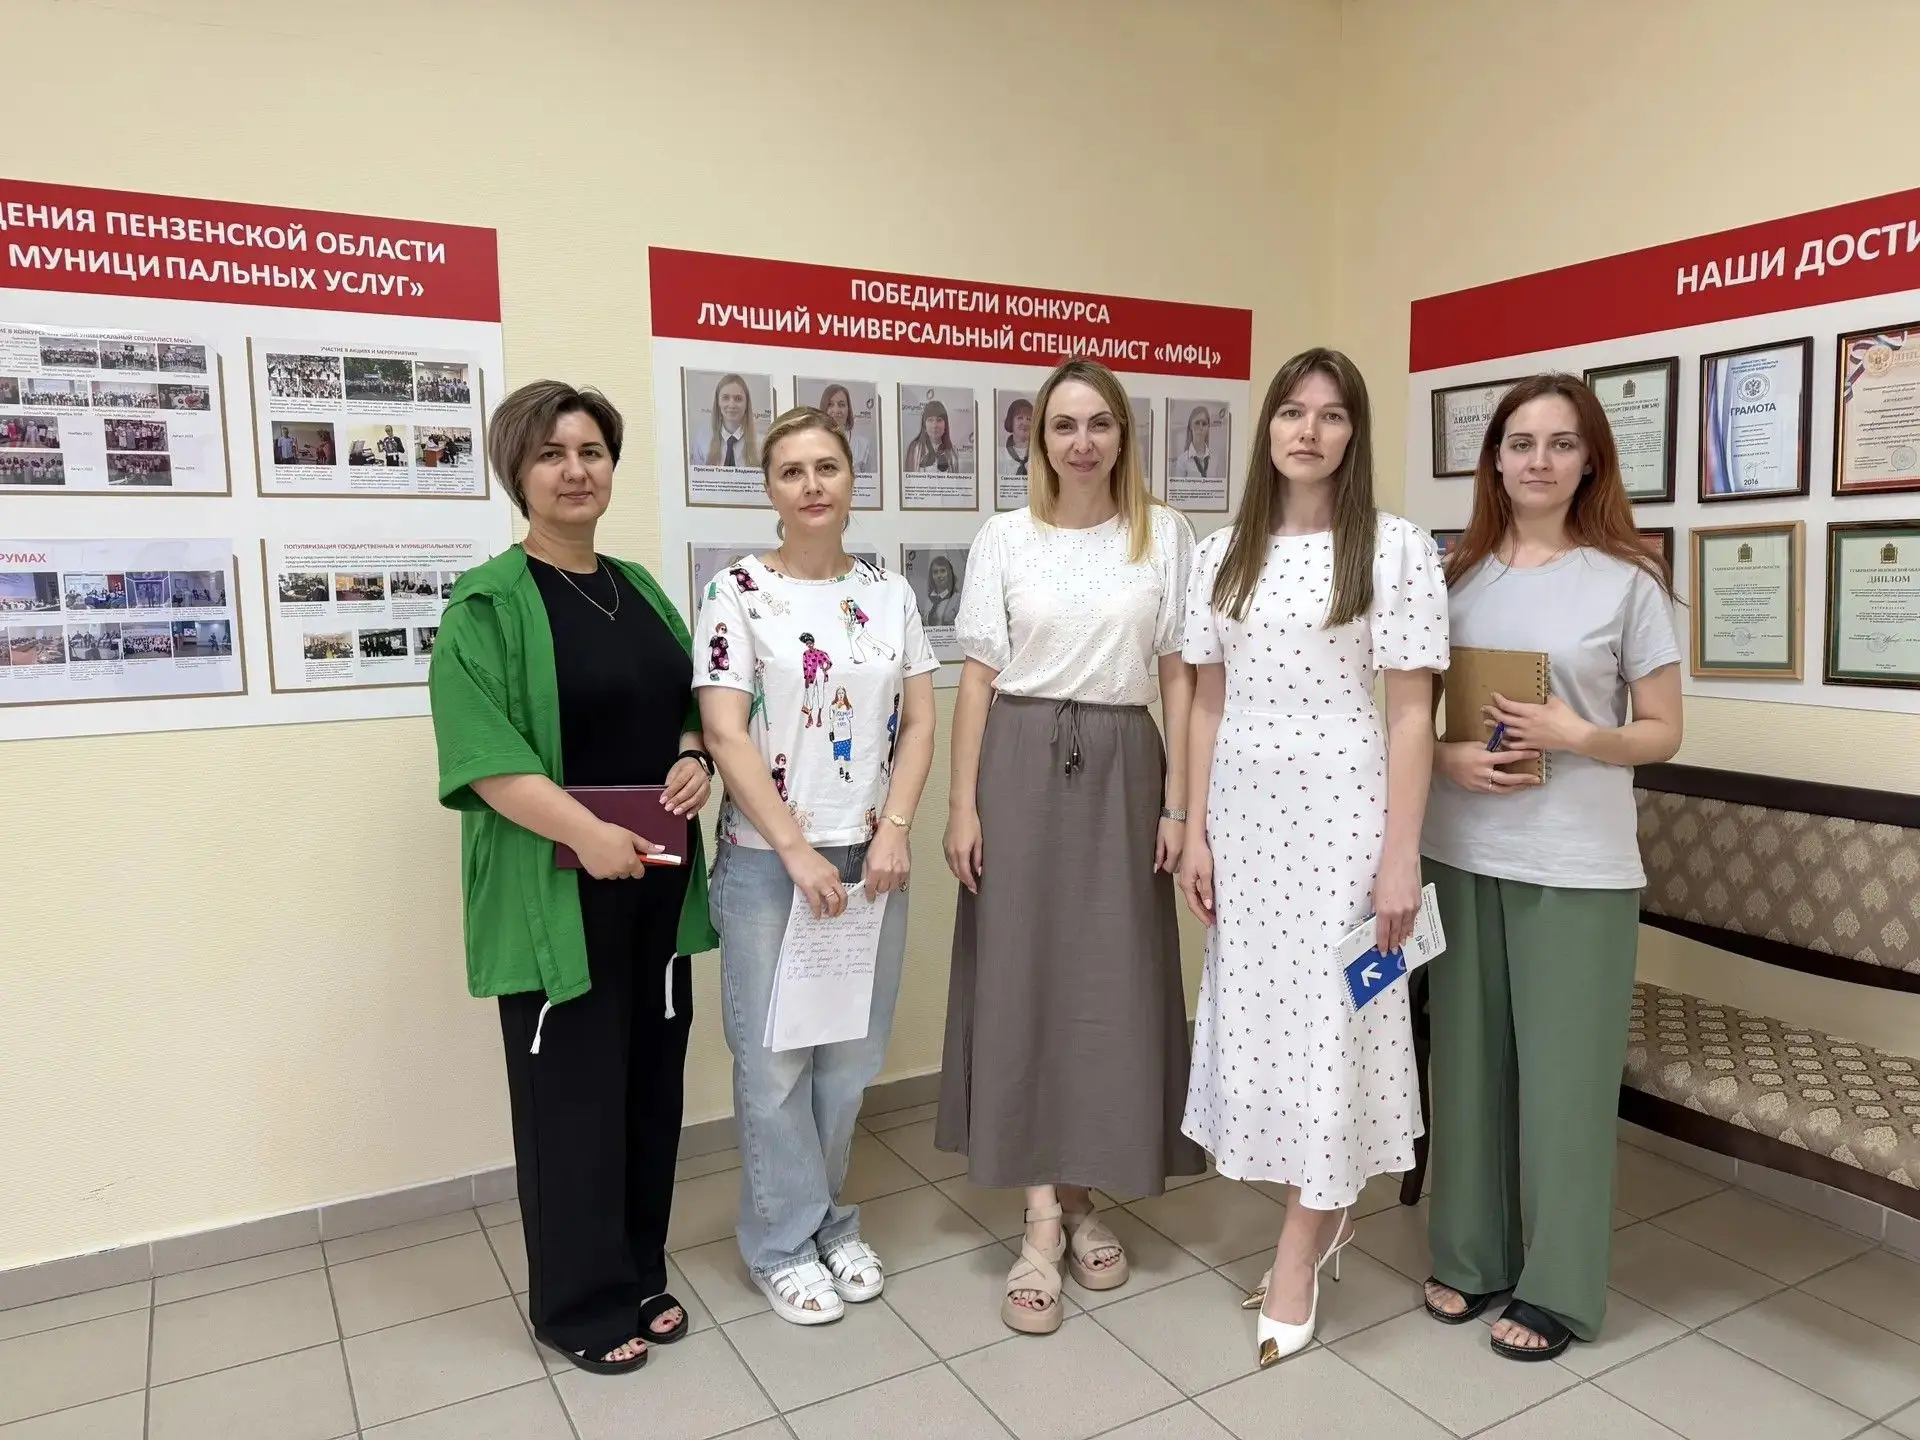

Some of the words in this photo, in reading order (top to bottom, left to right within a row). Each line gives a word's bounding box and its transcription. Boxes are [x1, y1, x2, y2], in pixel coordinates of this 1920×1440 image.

[106, 212, 308, 252] ПЕНЗЕНСКОЙ
[315, 231, 446, 265] ОБЛАСТИ
[323, 269, 425, 297] УСЛУГ»
[1676, 246, 1786, 296] НАШИ
[851, 279, 999, 314] ПОБЕДИТЕЛИ
[1006, 294, 1110, 324] КОНКУРСА
[697, 302, 810, 334] ЛУЧШИЙ
[816, 313, 1014, 351] УНИВЕРСАЛЬНЫЙ
[1019, 331, 1150, 360] СПЕЦИАЛИСТ
[1154, 343, 1221, 369] «МФЦ»
[1730, 402, 1777, 416] ГРАМОТА
[1867, 575, 1911, 583] ДИПЛОМ
